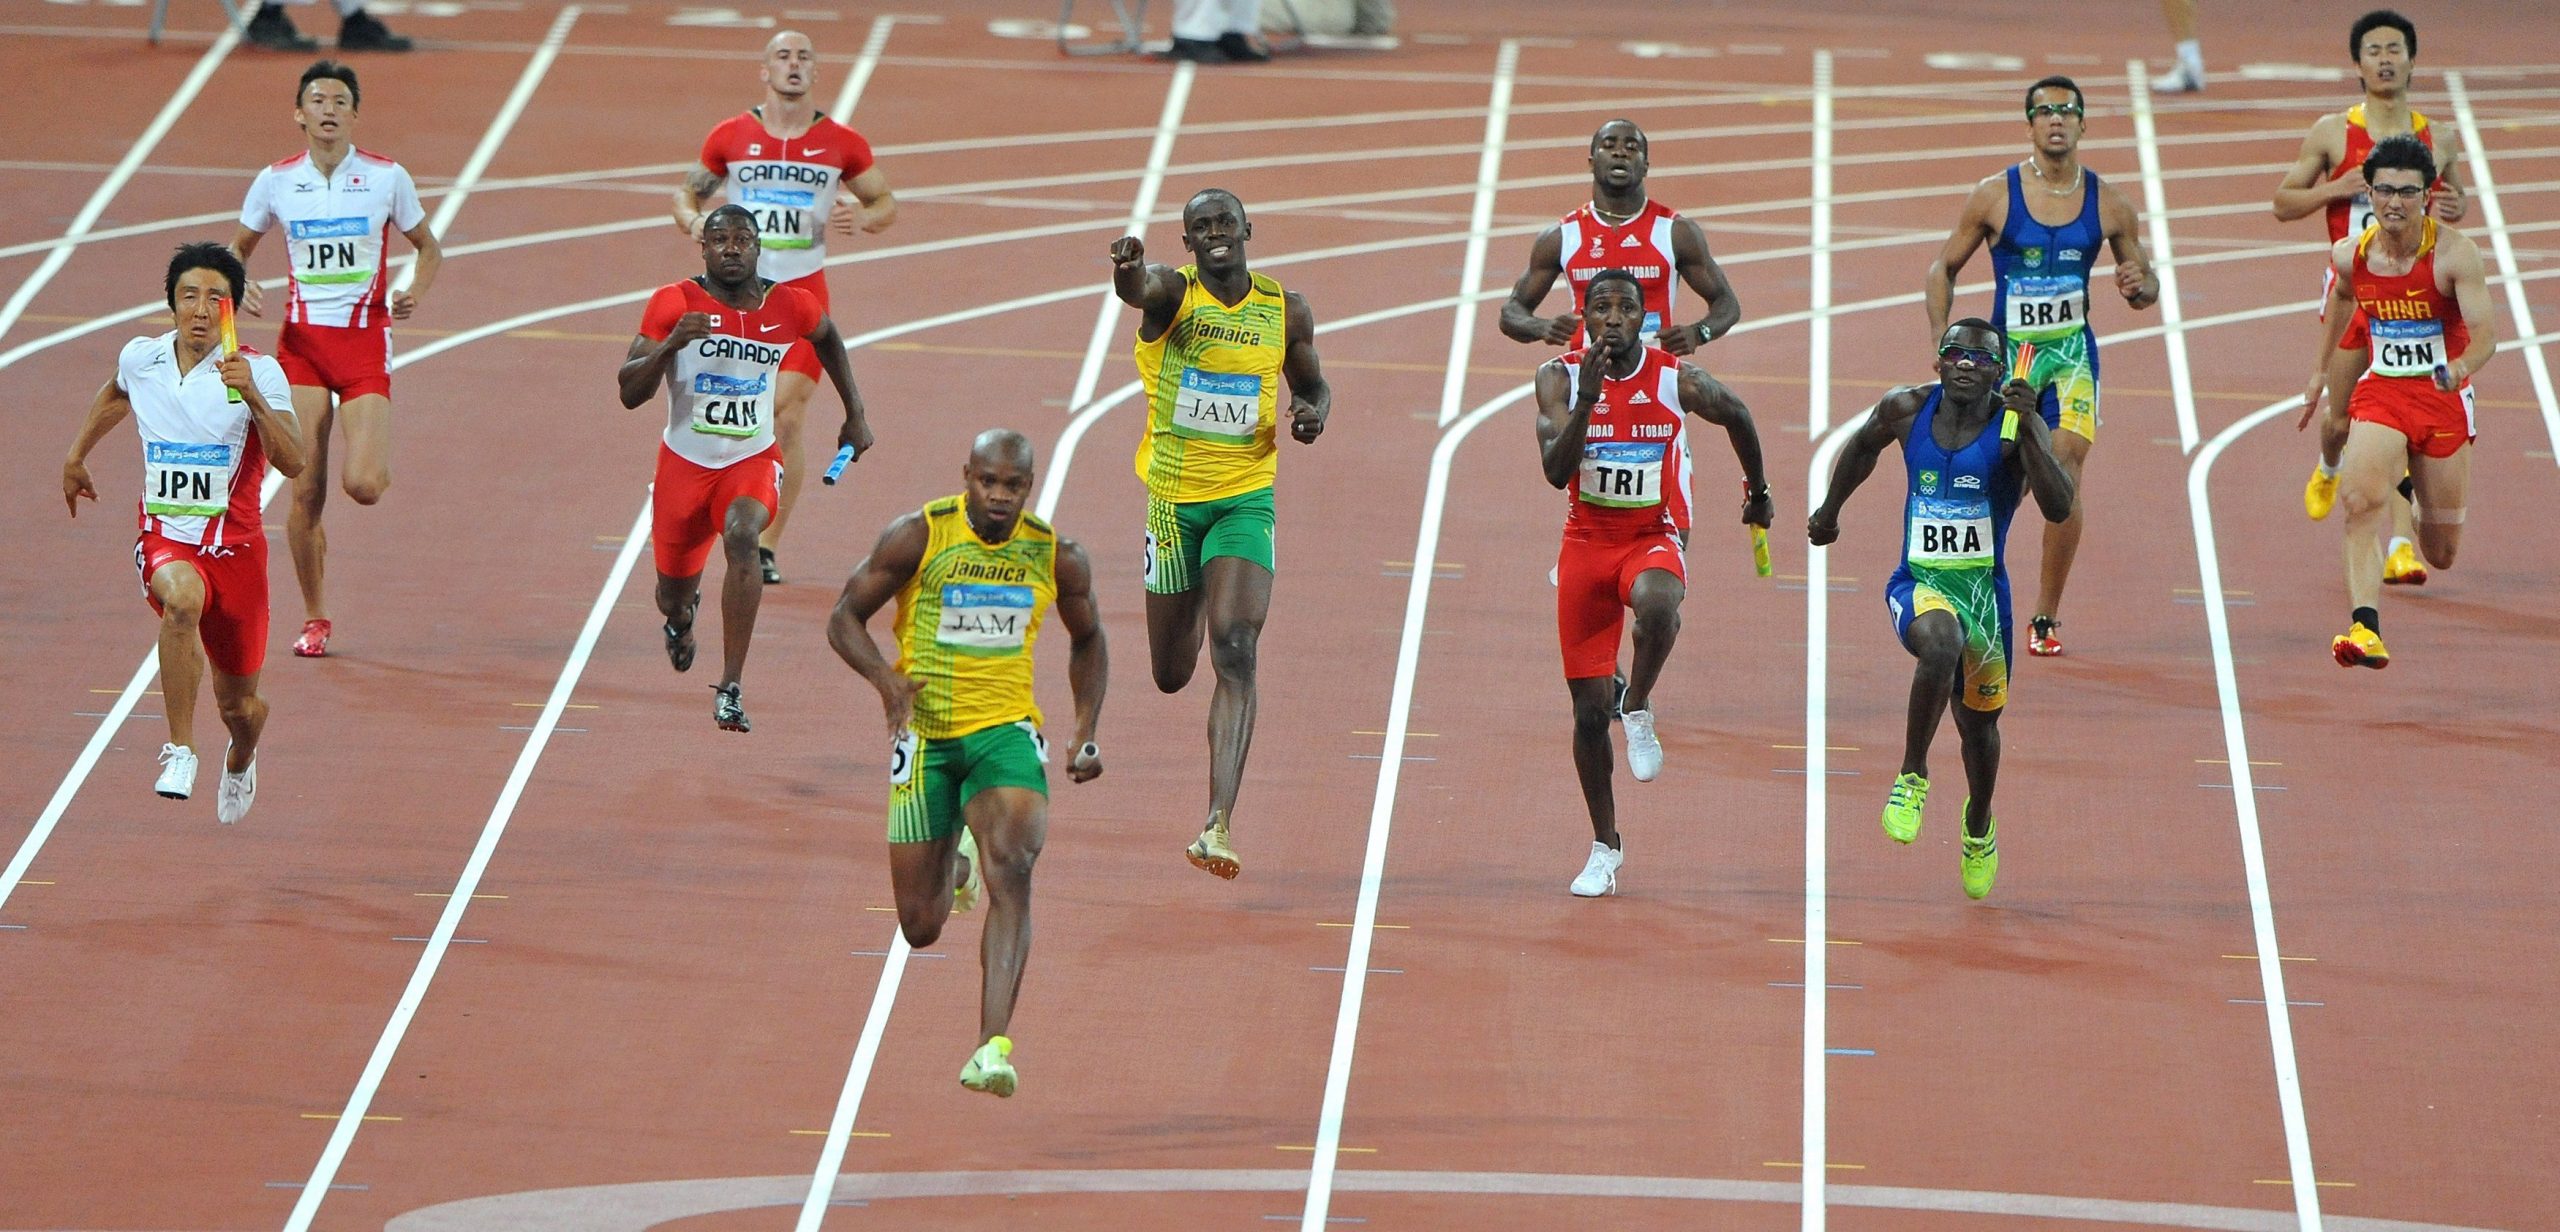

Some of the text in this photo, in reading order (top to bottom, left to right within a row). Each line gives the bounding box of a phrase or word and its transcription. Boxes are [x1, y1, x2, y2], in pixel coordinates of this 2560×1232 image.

[738, 165, 828, 188] CANADA
[307, 242, 355, 269] JPN
[2020, 300, 2073, 326] BRA
[699, 338, 781, 366] CANADA
[2382, 342, 2433, 366] CHN
[705, 399, 758, 427] CAN
[1188, 398, 1248, 425] JAM
[1639, 423, 1673, 437] TOBAGO
[158, 470, 211, 500] JPN
[1597, 466, 1644, 496] TRI
[1923, 525, 1981, 553] BRA
[952, 613, 1016, 635] JAM
